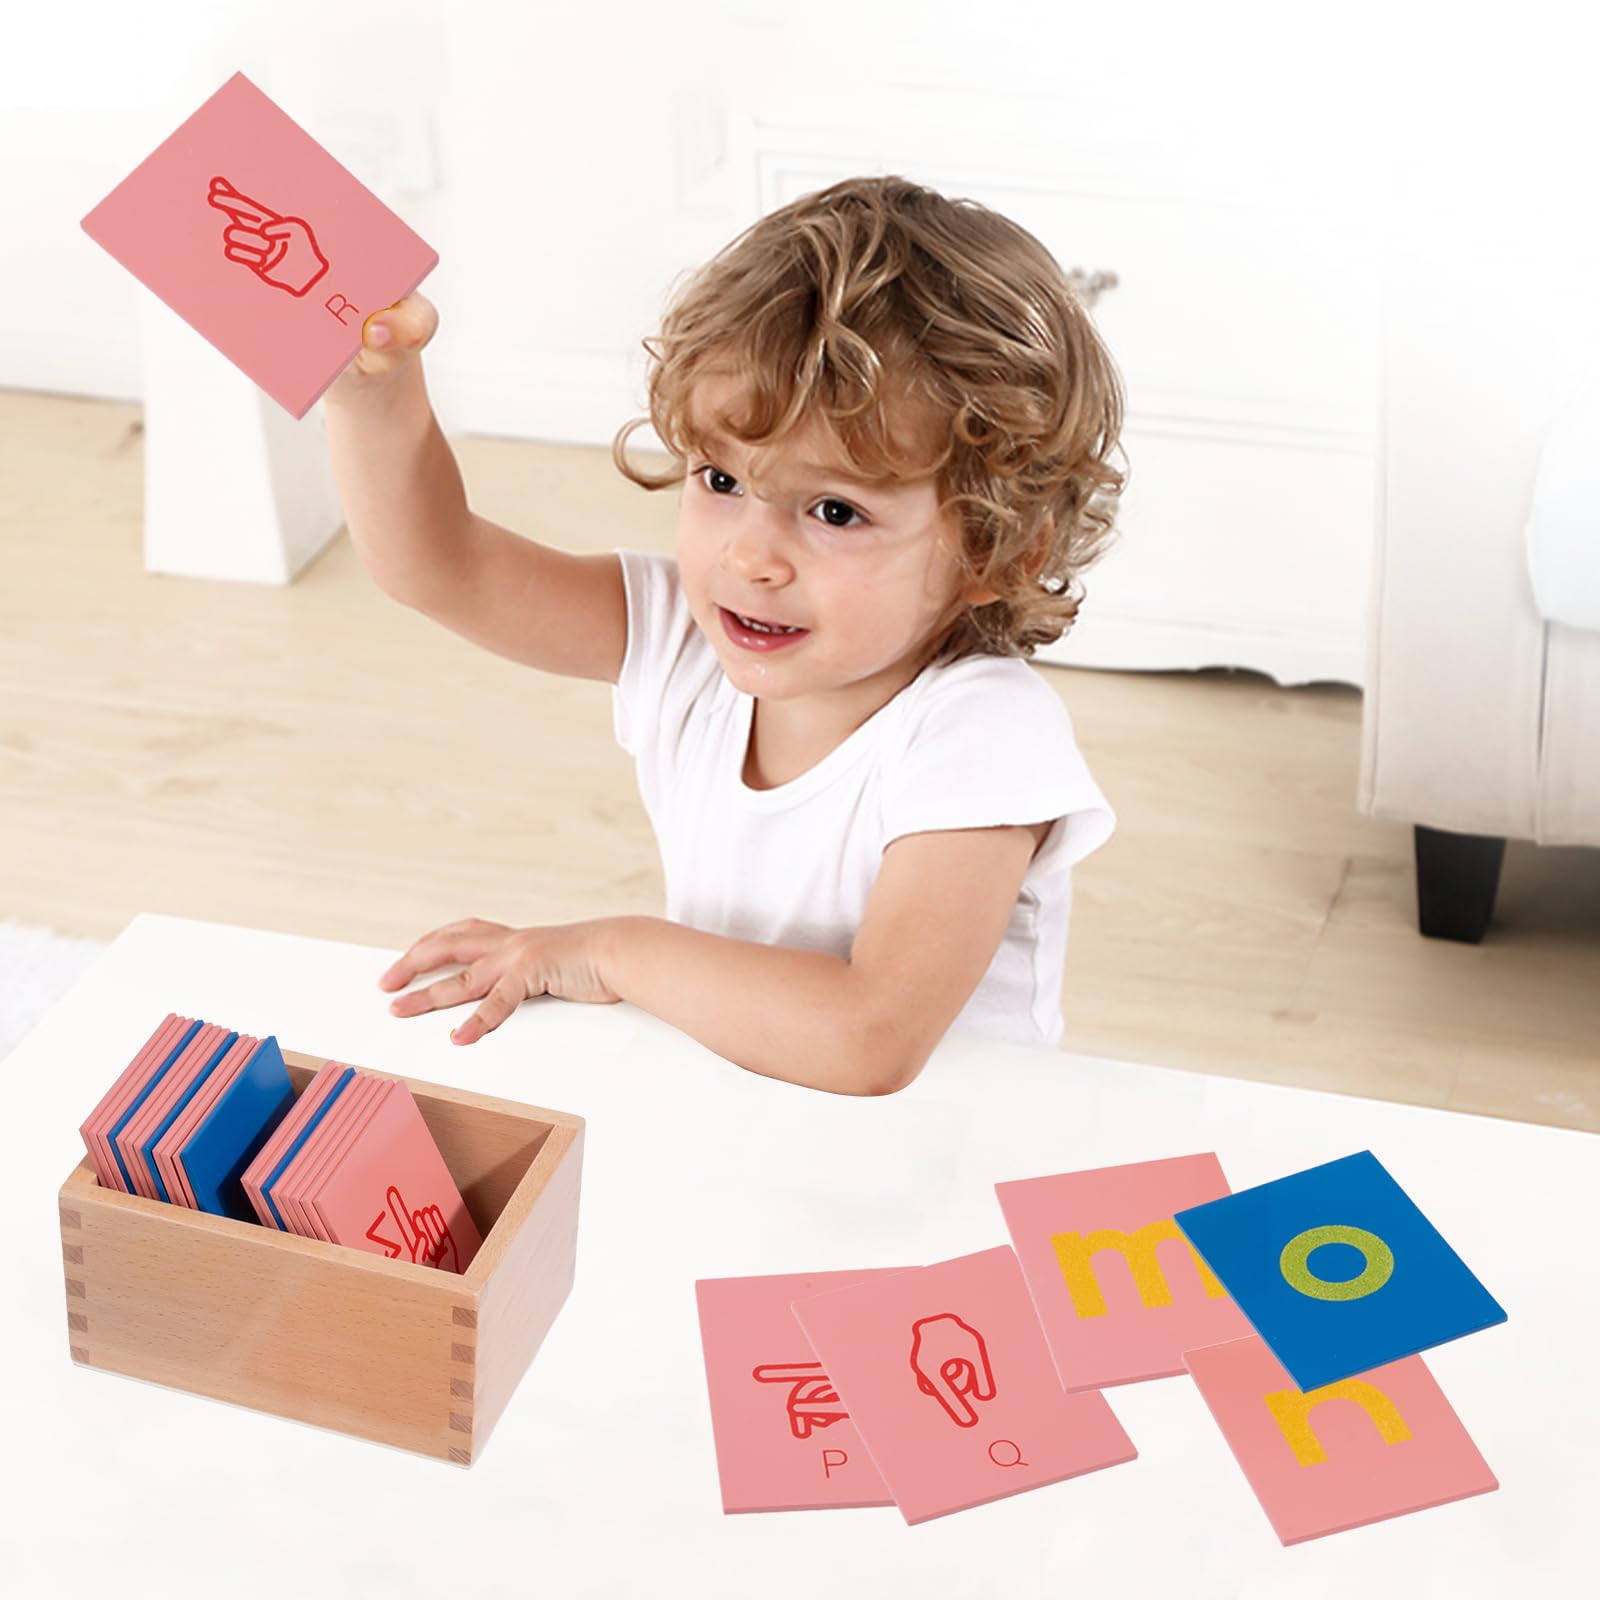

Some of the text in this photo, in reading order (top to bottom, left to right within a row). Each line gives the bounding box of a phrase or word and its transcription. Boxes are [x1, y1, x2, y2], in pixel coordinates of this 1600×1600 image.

[325, 294, 360, 326] R
[1051, 1219, 1228, 1319] m
[1264, 1379, 1413, 1467] n
[822, 1450, 848, 1479] P
[988, 1440, 1029, 1468] Q
